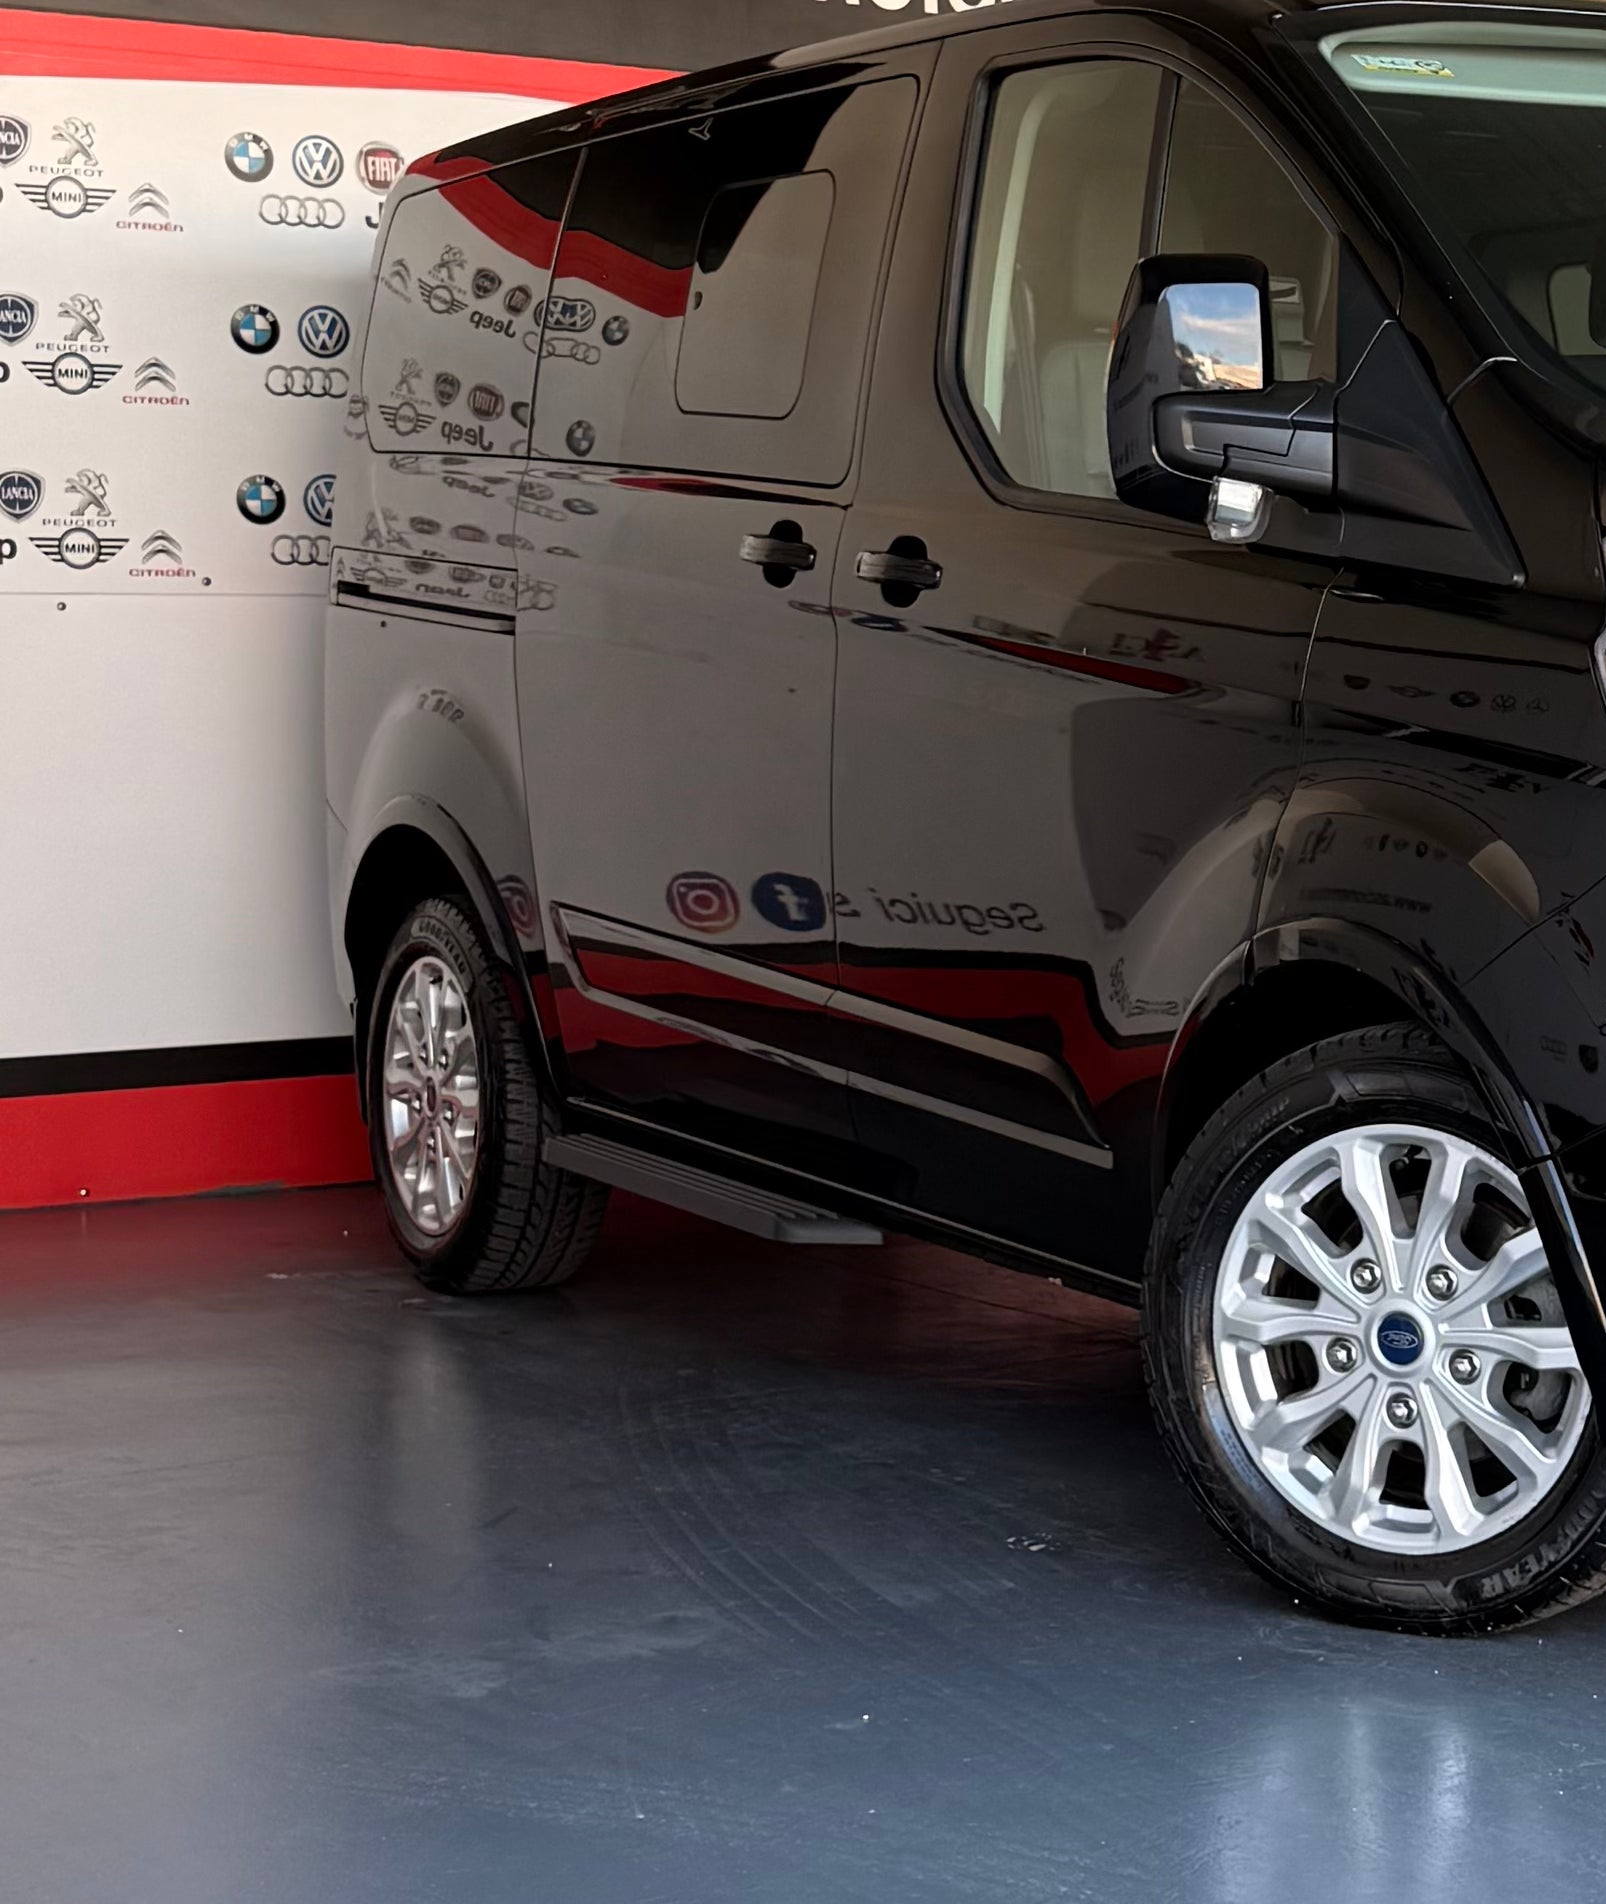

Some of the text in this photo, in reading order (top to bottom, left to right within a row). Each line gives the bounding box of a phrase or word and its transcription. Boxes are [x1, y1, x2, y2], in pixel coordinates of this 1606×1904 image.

[29, 165, 104, 178] PEUGEOT
[367, 156, 397, 182] FIAT
[52, 190, 82, 203] MINI
[36, 342, 110, 353] PEUGEOT
[58, 368, 88, 380] MINI
[42, 518, 118, 528] PEUGEOT
[65, 542, 95, 554] MINI
